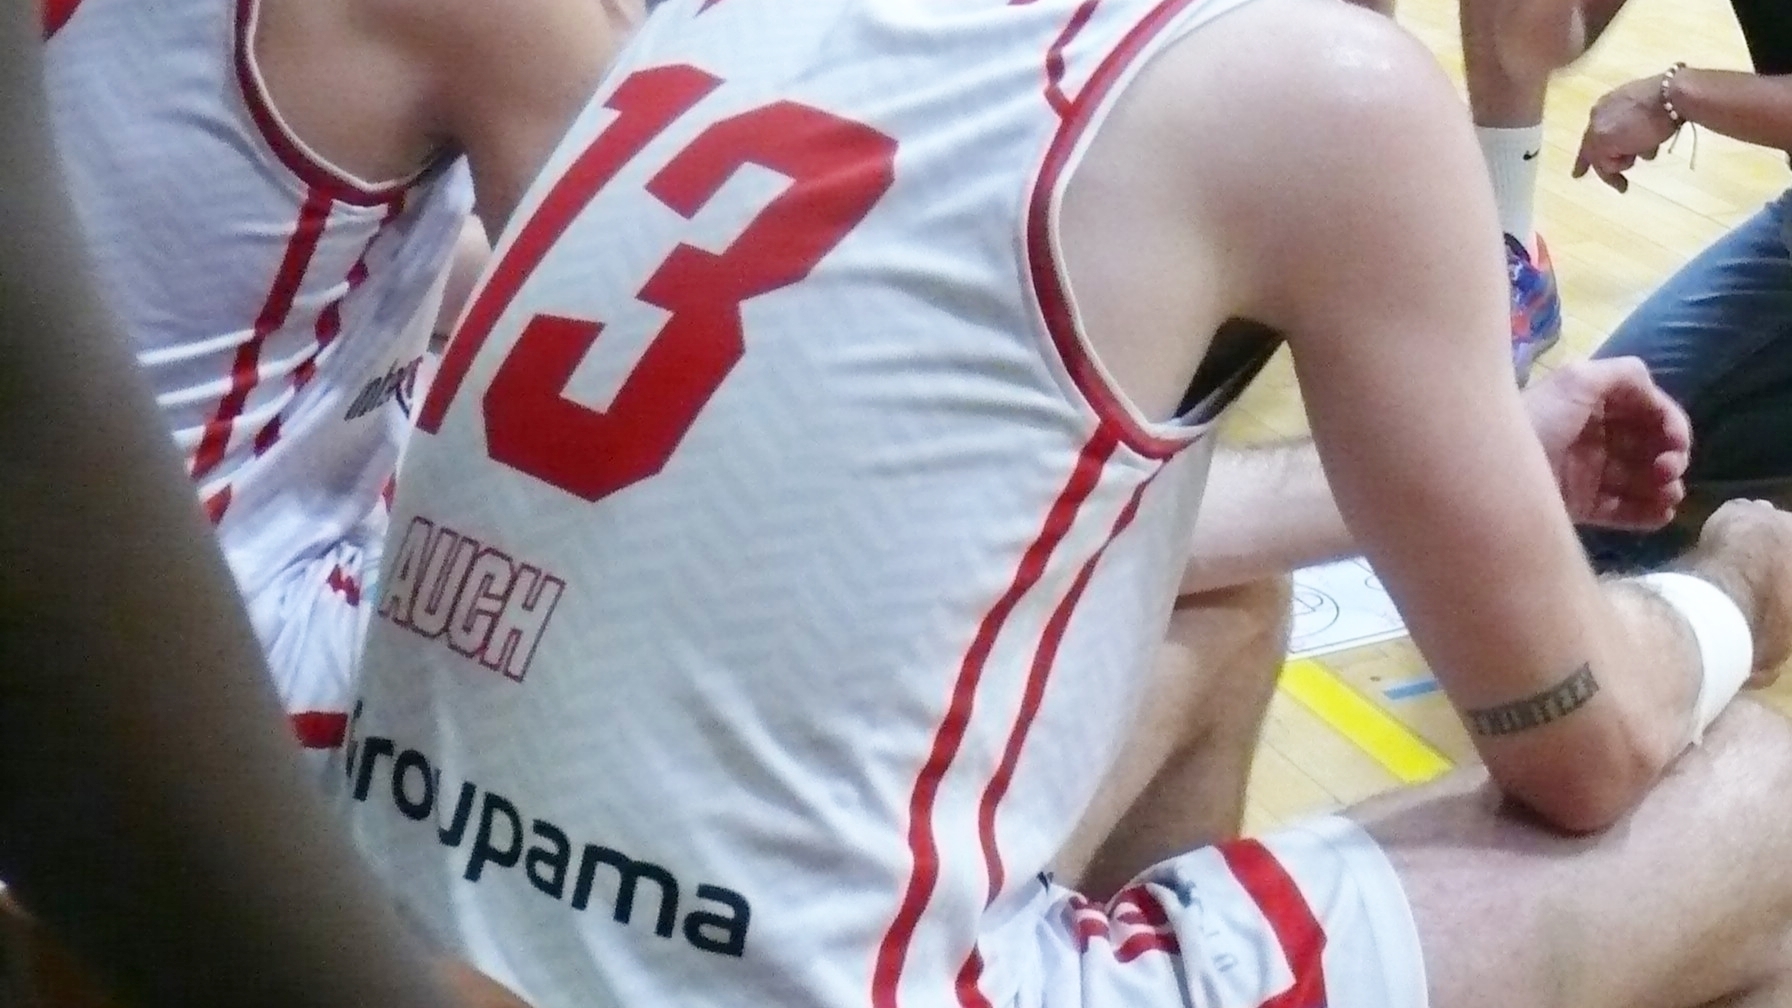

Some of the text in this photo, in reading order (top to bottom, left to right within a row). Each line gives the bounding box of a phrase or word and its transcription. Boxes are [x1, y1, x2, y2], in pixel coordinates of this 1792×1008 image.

[416, 63, 899, 503] 13
[378, 516, 565, 683] AUCH
[345, 698, 752, 957] roupama
